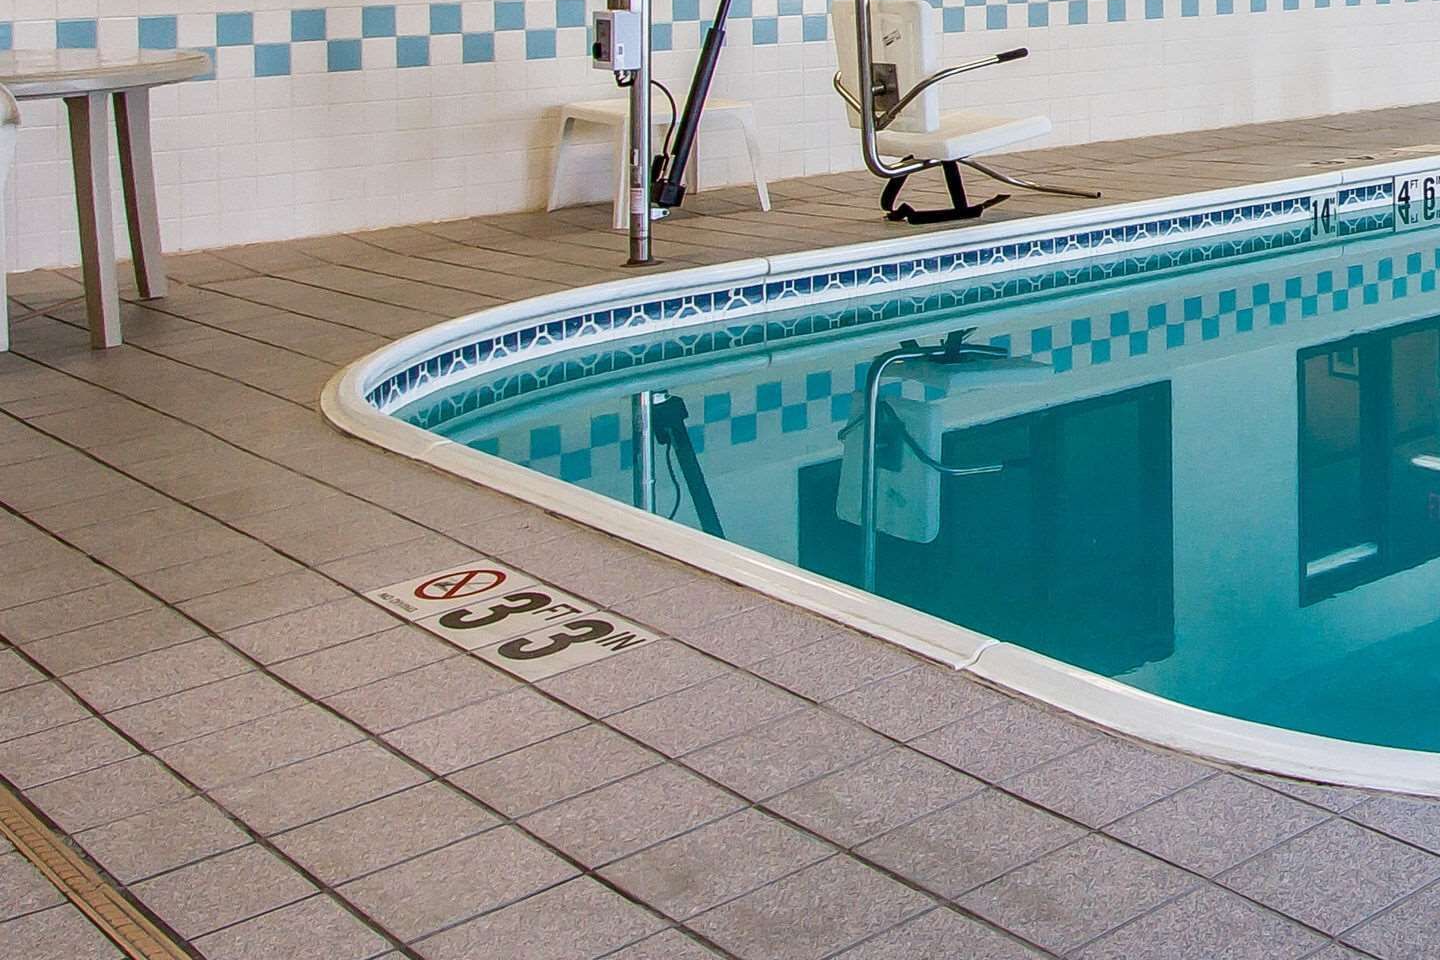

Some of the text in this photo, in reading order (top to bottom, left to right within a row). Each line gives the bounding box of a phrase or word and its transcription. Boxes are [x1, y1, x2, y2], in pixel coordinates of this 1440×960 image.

[1398, 180, 1411, 203] 4
[1411, 179, 1419, 189] FT
[1424, 177, 1435, 200] 6
[440, 592, 583, 629] 3 FT
[498, 619, 647, 660] 3 IN
